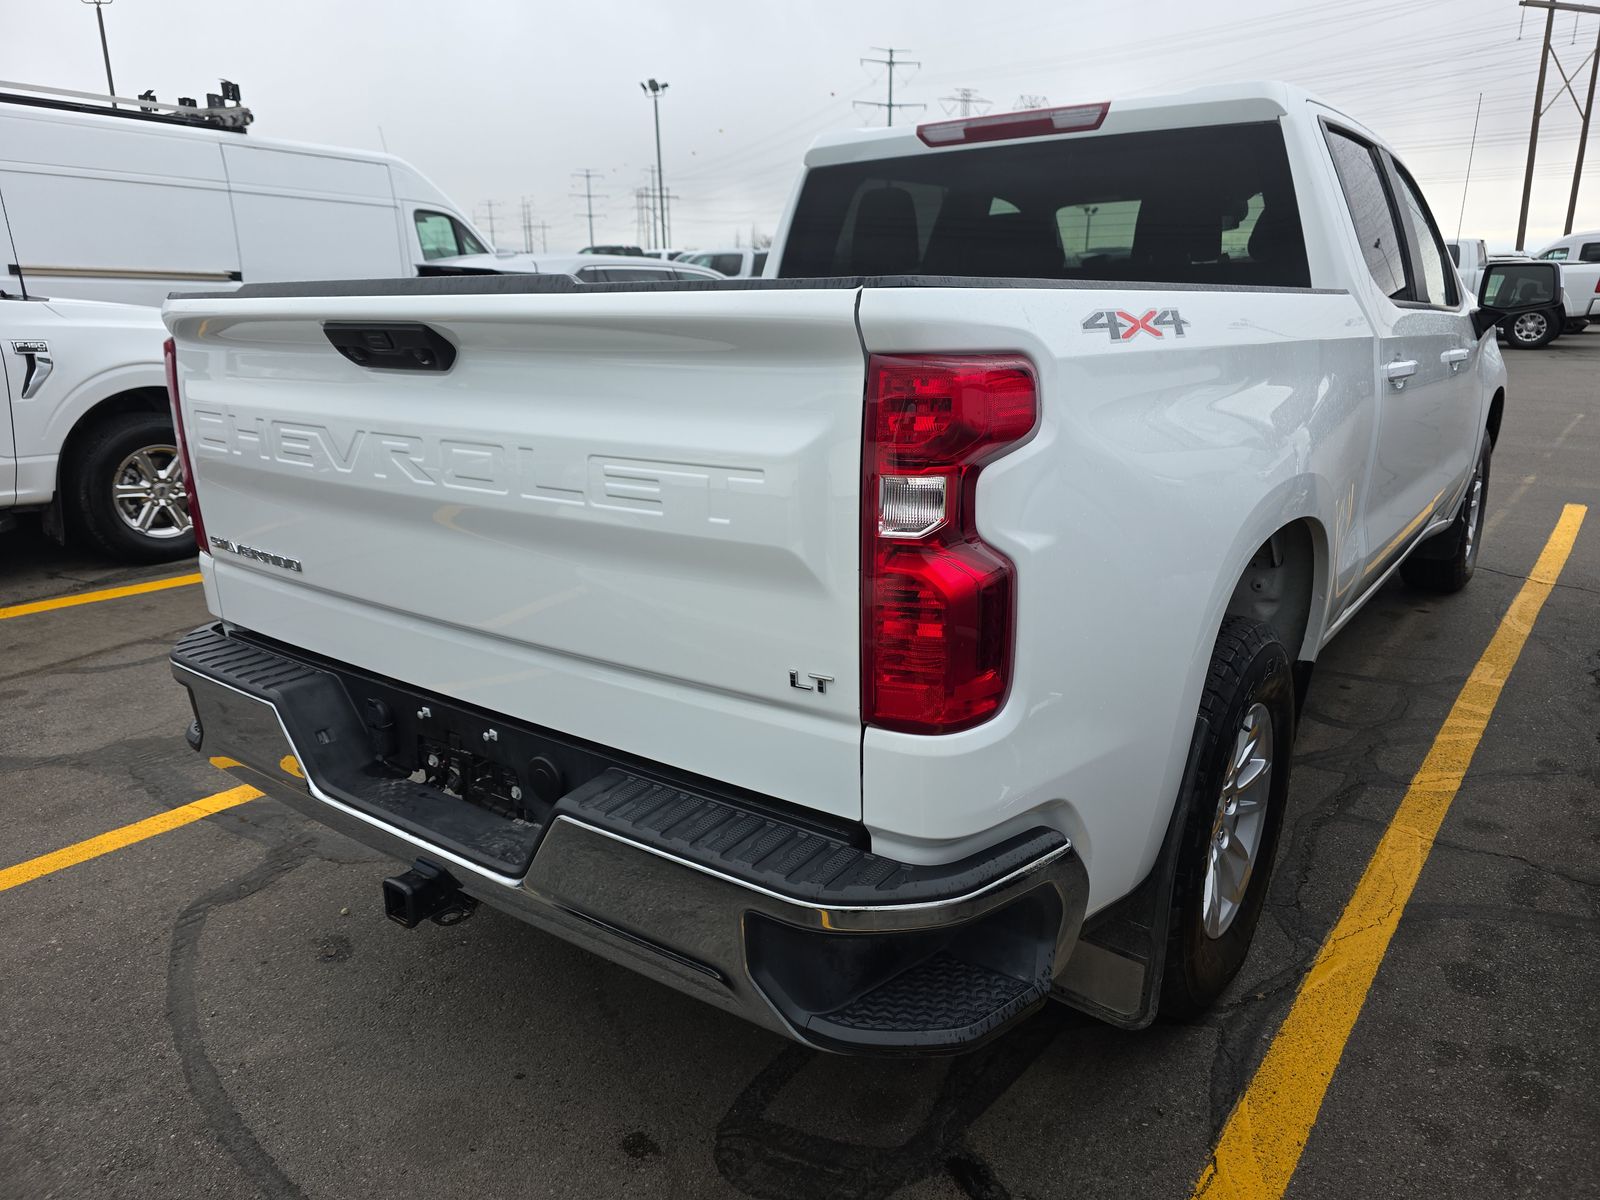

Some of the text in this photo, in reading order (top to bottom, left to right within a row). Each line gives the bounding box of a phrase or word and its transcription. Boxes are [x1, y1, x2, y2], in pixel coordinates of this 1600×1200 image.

[193, 409, 765, 525] CHEVROLET
[210, 536, 303, 572] SILVERADO
[789, 669, 834, 694] LT
